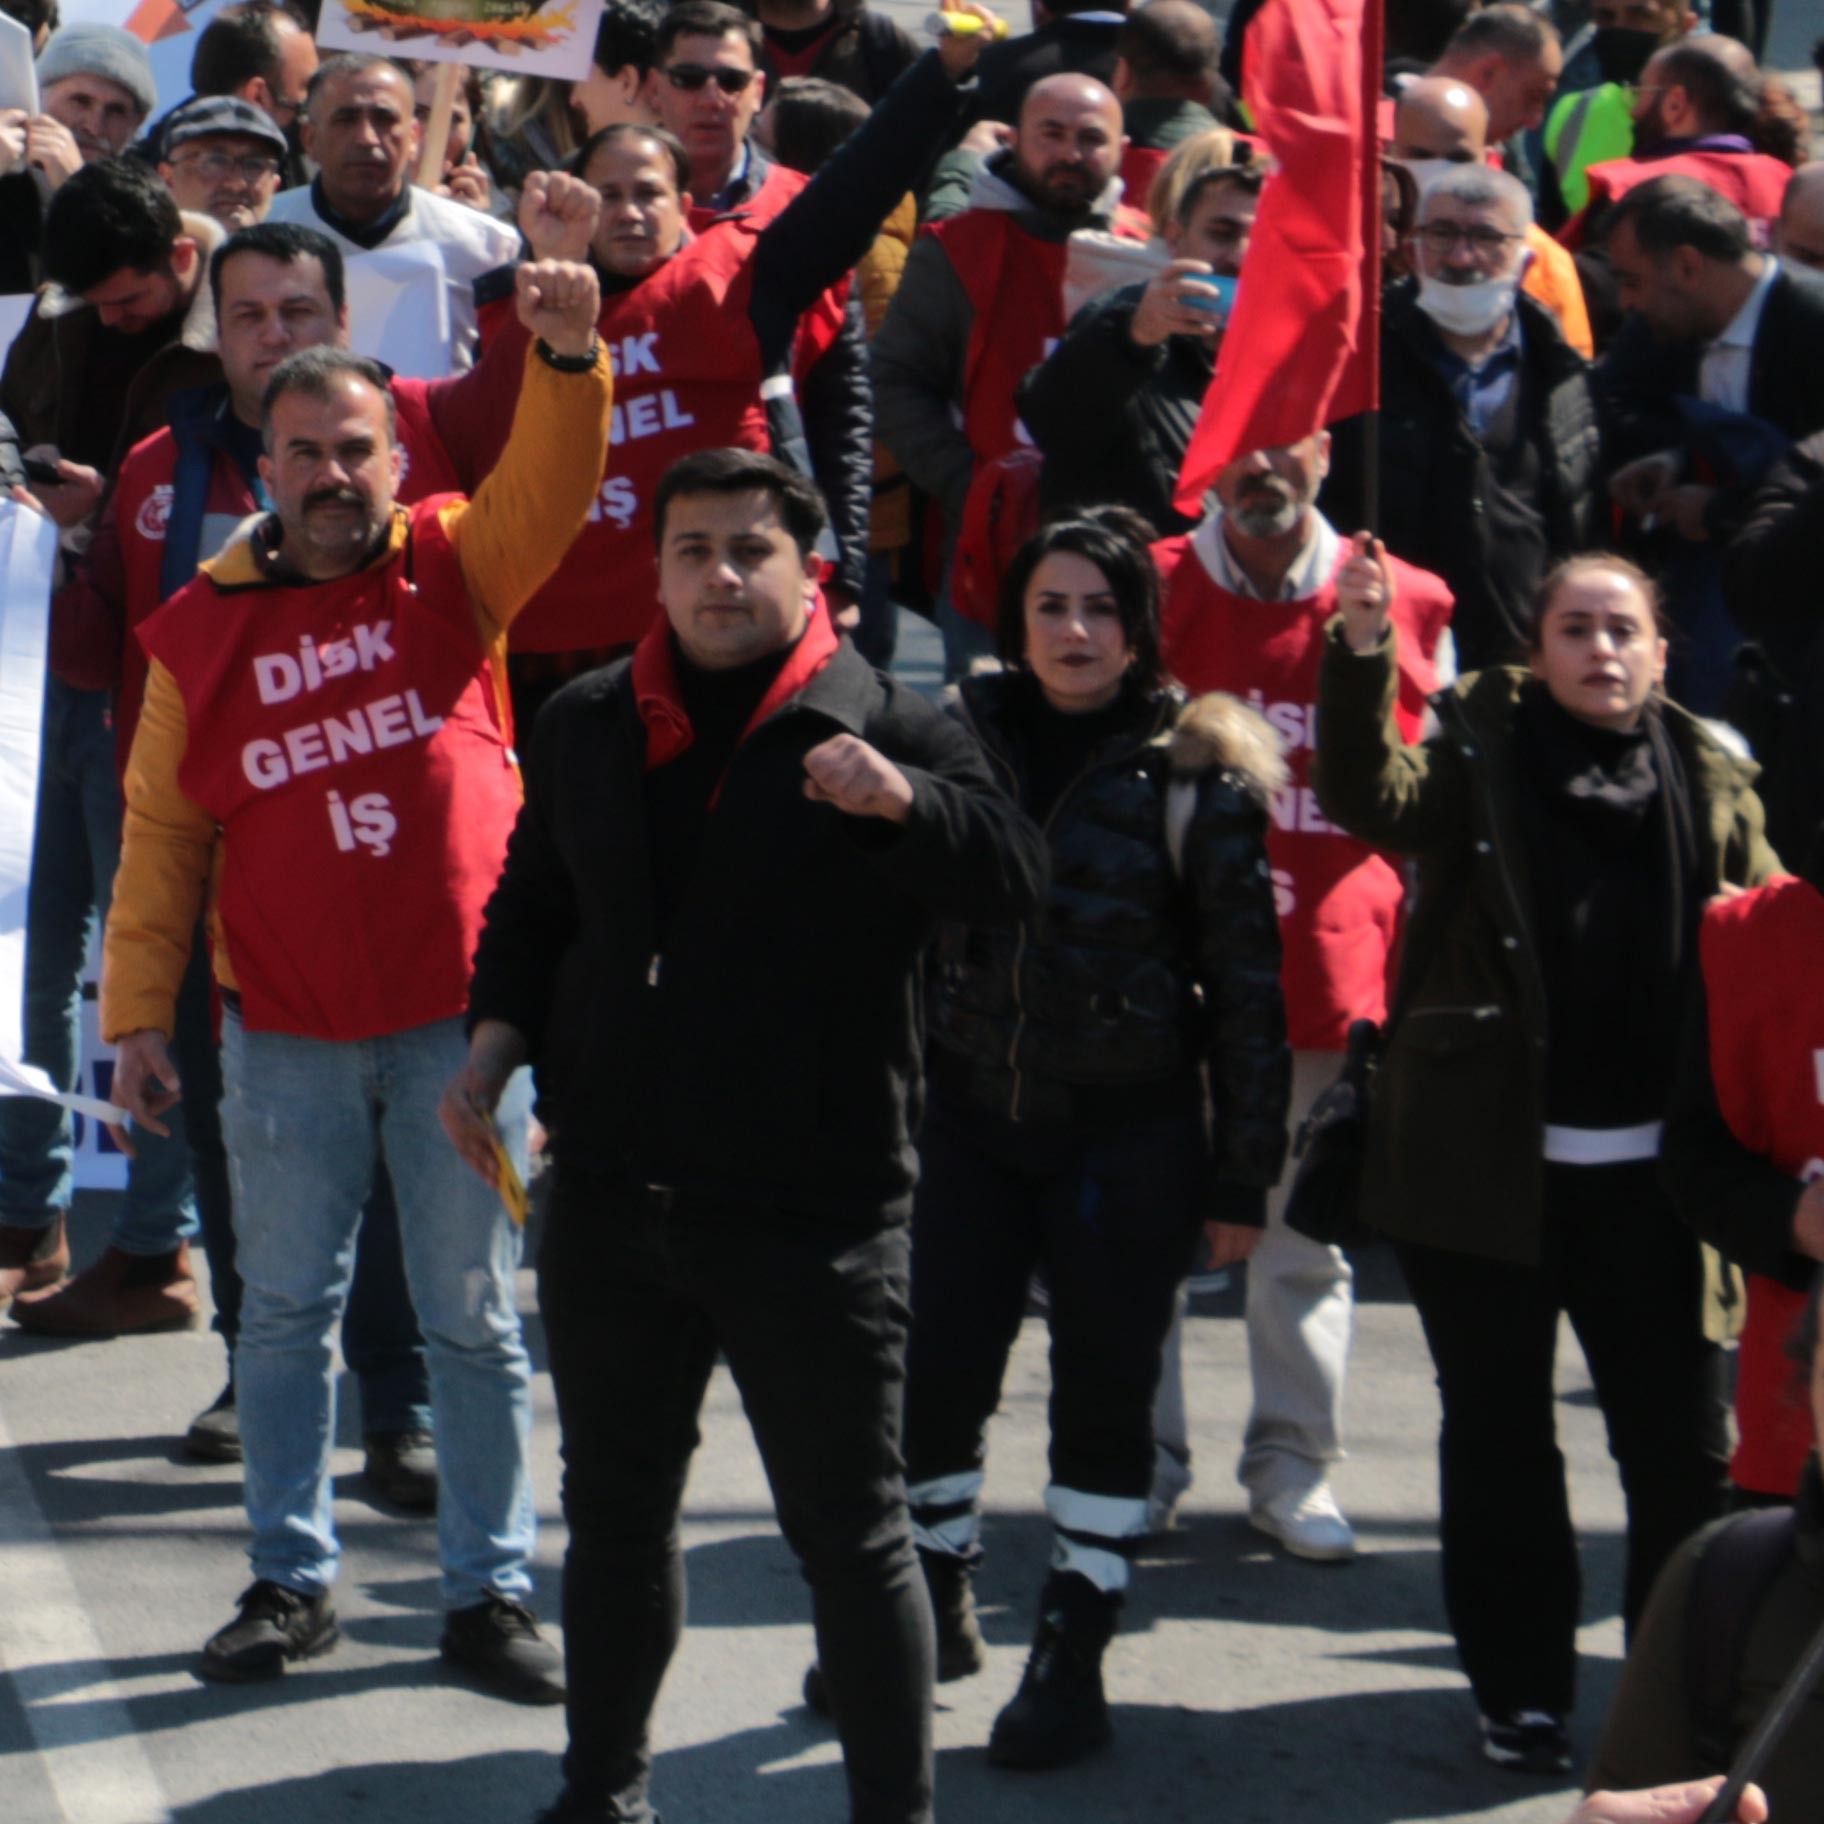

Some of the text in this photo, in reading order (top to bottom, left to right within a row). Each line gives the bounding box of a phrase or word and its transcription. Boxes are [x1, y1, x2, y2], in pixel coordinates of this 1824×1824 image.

[253, 619, 397, 707] DİSK
[241, 687, 445, 792] GENEL
[326, 788, 398, 858] İŞ
